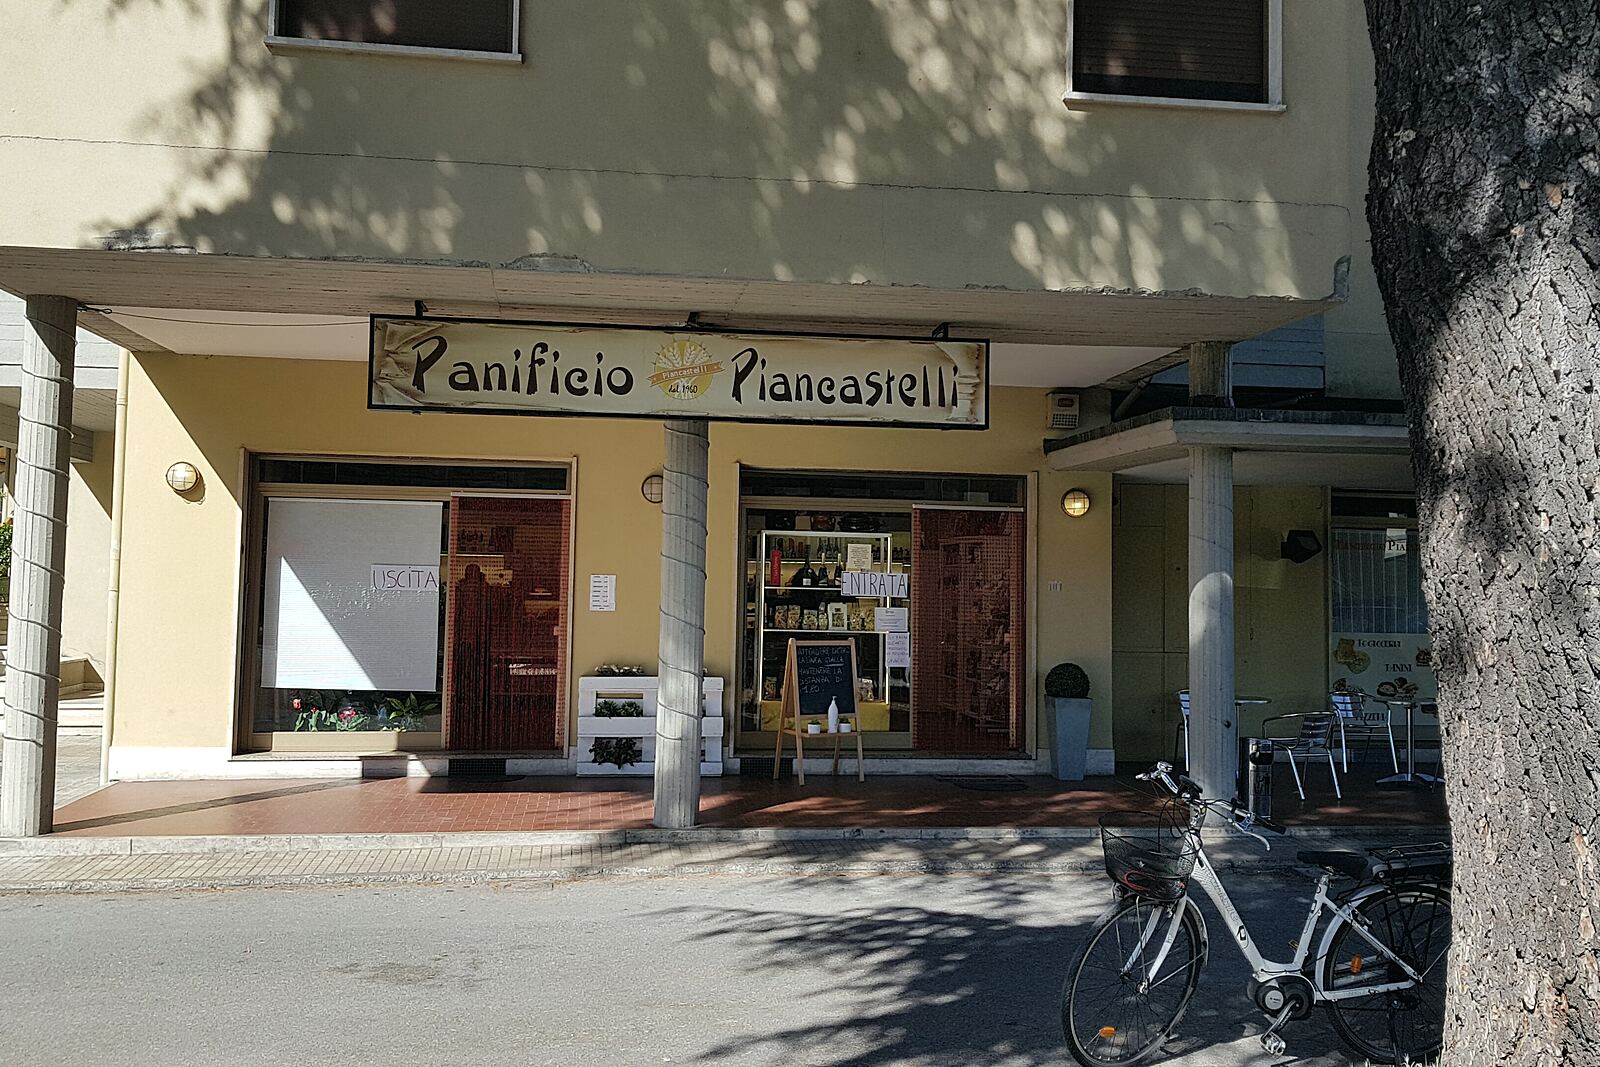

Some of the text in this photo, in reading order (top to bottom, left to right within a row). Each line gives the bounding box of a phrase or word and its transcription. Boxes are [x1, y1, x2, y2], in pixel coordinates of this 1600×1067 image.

[412, 336, 959, 408] Panificio Piancastelli
[662, 365, 708, 379] Piancastelli
[682, 385, 698, 394] 1960
[842, 572, 908, 597] ENTRATA
